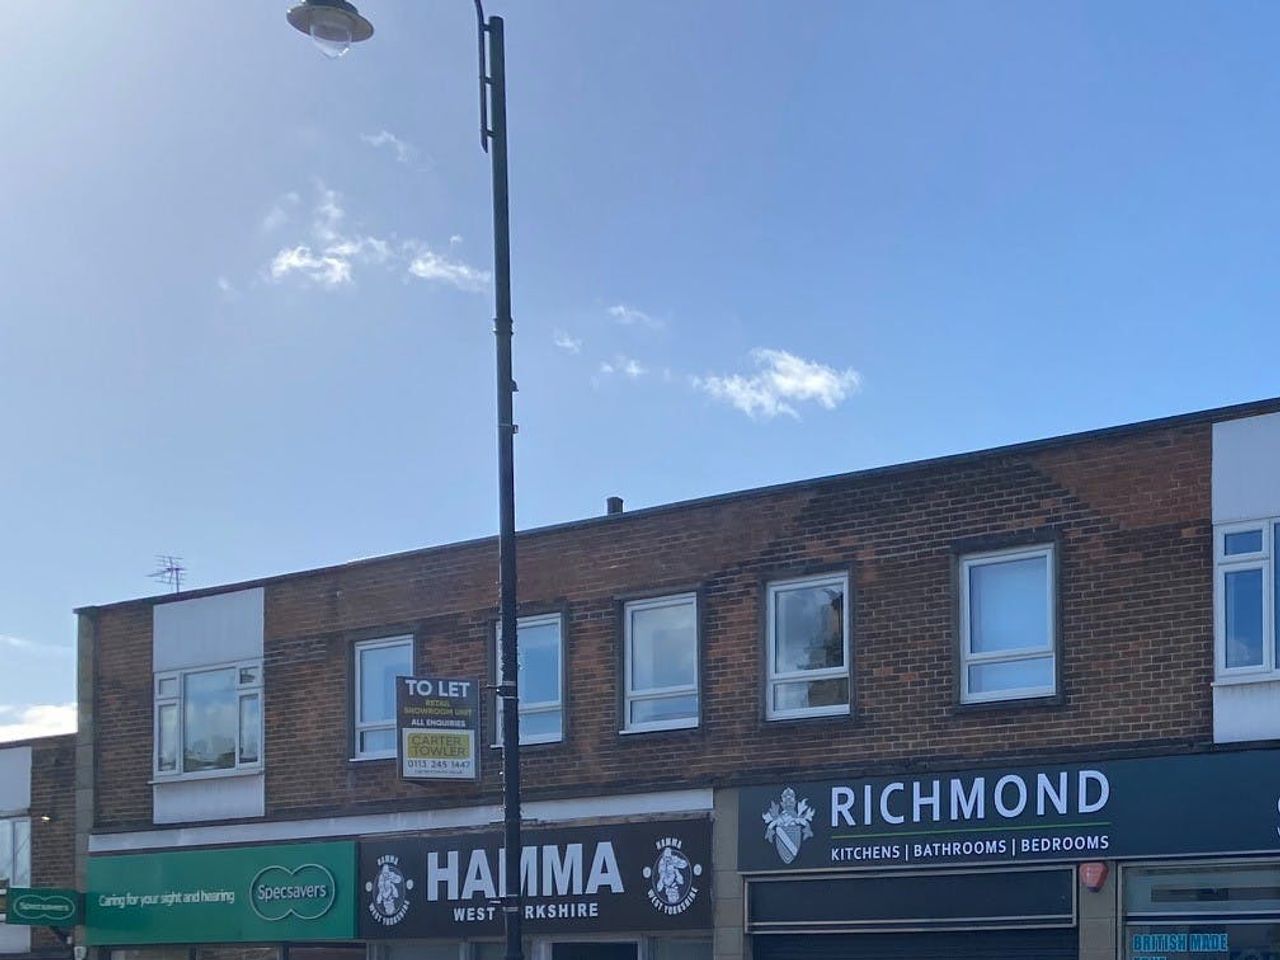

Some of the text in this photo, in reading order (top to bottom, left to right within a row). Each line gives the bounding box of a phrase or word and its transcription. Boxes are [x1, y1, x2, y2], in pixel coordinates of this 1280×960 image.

[405, 680, 470, 698] TO LET
[411, 718, 466, 727] ALL ENQUIRIES
[412, 735, 461, 746] CARTER
[413, 746, 466, 757] TOWLER
[407, 760, 471, 769] 0113 245 1447
[830, 770, 1111, 827] RICHMOND
[831, 835, 1110, 862] KITCHENS BATHROOMS BEDROOMS
[99, 889, 235, 909] Caring for your sight and hearing
[258, 881, 327, 901] Specsavers
[454, 903, 598, 921] WEST RKSHIRE
[1133, 933, 1228, 952] BRITISH MADE
